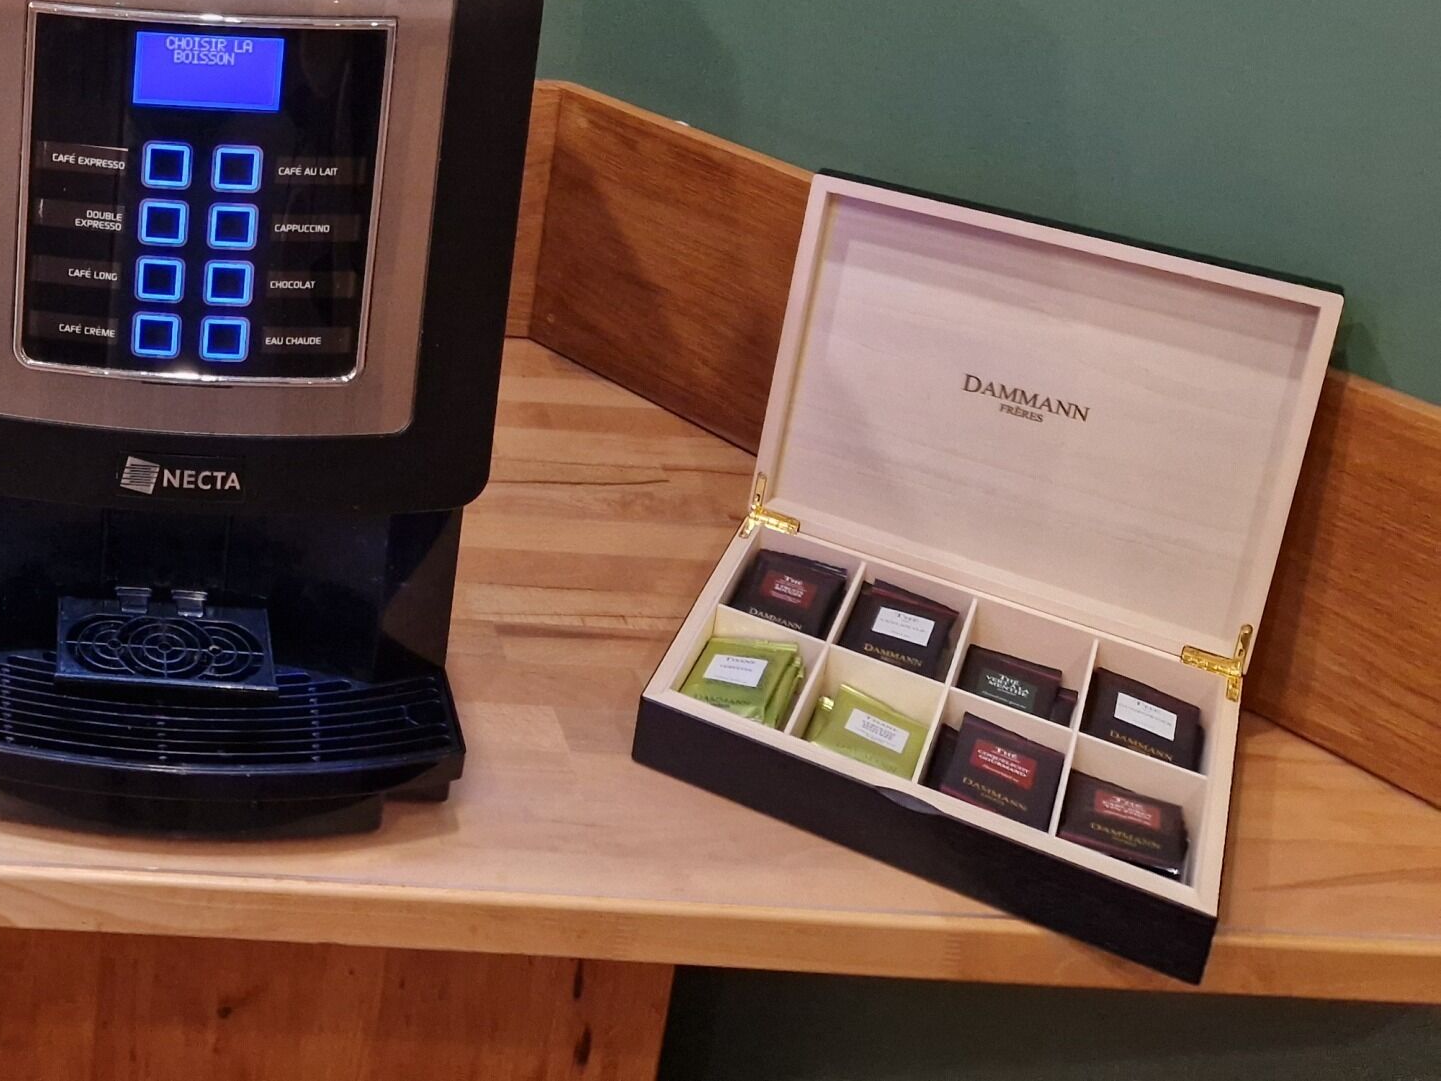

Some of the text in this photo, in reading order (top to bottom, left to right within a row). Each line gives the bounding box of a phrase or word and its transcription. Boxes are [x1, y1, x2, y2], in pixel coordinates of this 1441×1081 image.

[166, 36, 253, 53] CHOISIR LA
[174, 50, 234, 65] BOISSON
[52, 153, 126, 170] CAFÉ EXPRESSO
[278, 165, 339, 176] CAFÉ AU LAIT
[86, 209, 123, 222] DOUBLE
[75, 218, 122, 231] EXPRESSO
[274, 224, 330, 233] CAPPUCCINO
[68, 267, 118, 281] CAFÉ LONG
[269, 280, 316, 289] CHOCOLAT
[59, 322, 82, 334] CAFÉ
[265, 337, 322, 345] EAU CHAUDE
[962, 373, 1091, 422] DAMMANN
[999, 403, 1044, 423] FRÈRES
[162, 469, 241, 491] NECTA
[749, 607, 803, 631] DAMMANN
[863, 642, 923, 667] DAMMANN
[1109, 729, 1173, 762] DAMMANN
[962, 776, 1028, 812] DAMMANN
[1090, 822, 1160, 849] DAMMANN
